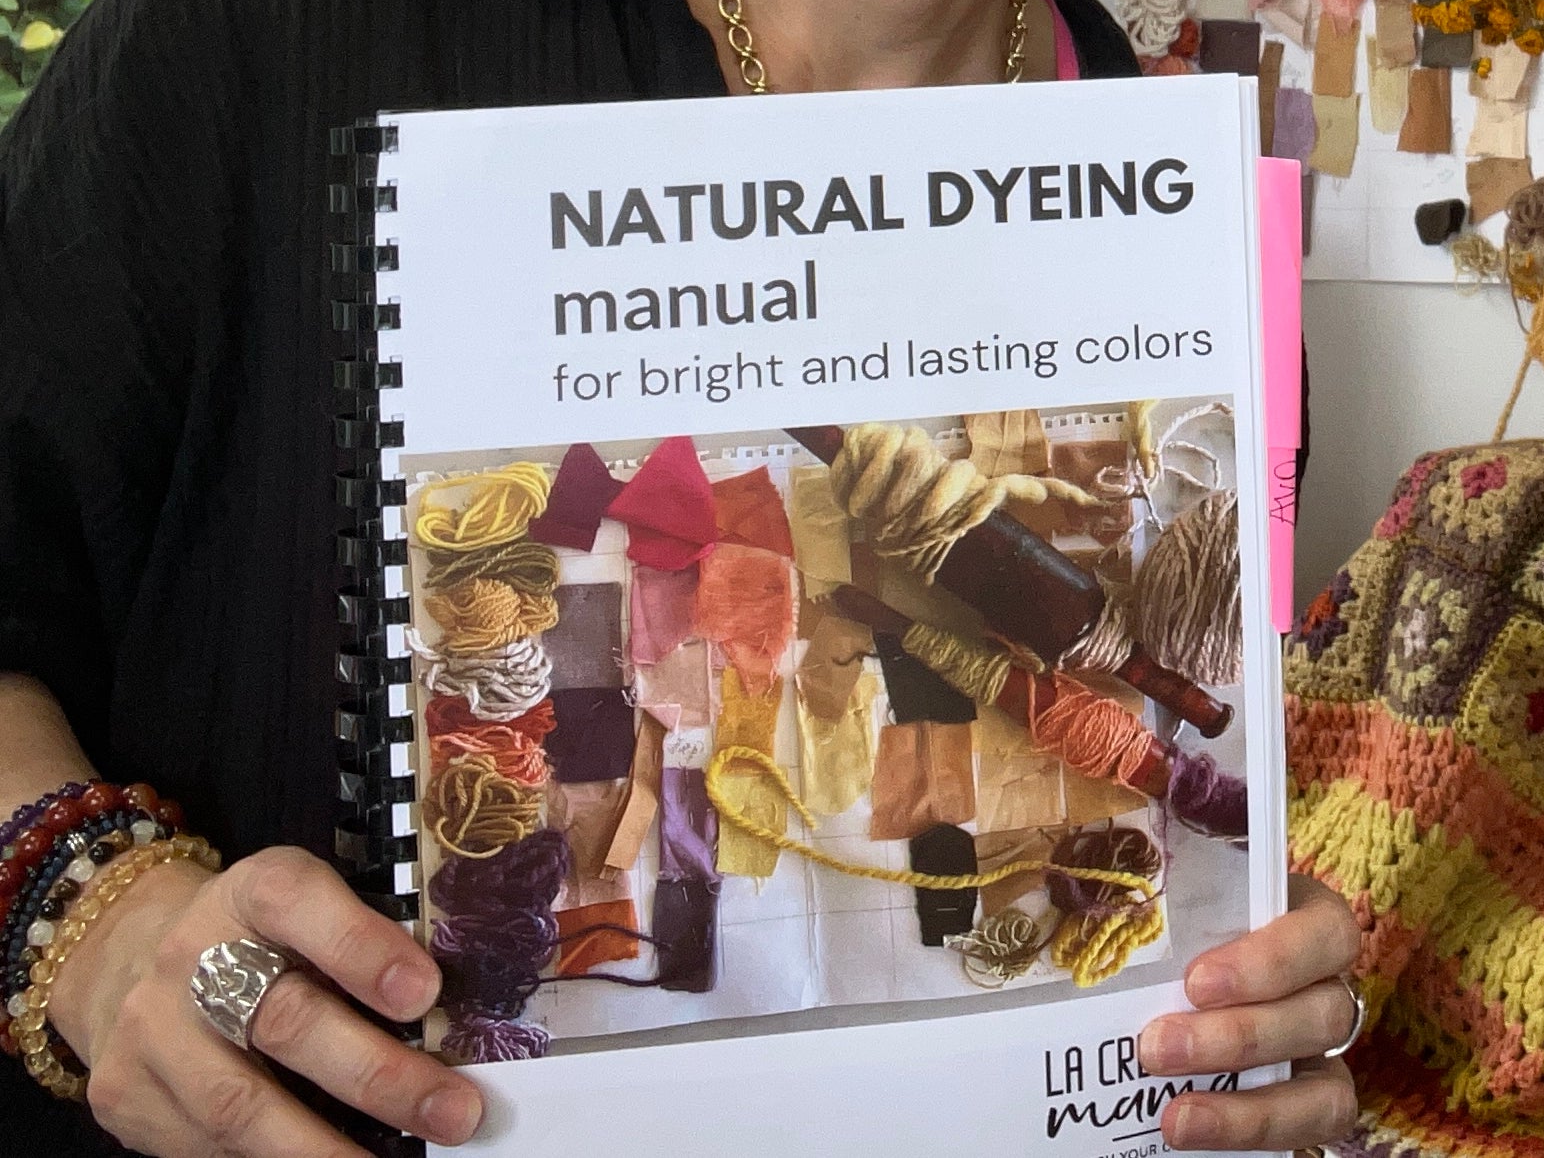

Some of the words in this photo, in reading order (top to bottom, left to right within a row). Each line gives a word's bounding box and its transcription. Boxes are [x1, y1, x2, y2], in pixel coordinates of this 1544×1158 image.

[550, 174, 905, 250] NATURAL
[927, 158, 1194, 228] DYEING
[554, 259, 818, 336] manual
[553, 362, 623, 402] for
[639, 351, 784, 404] bright
[801, 341, 889, 386] and
[907, 333, 1059, 379] lasting
[1075, 323, 1213, 364] colors
[1044, 1045, 1085, 1097] LA
